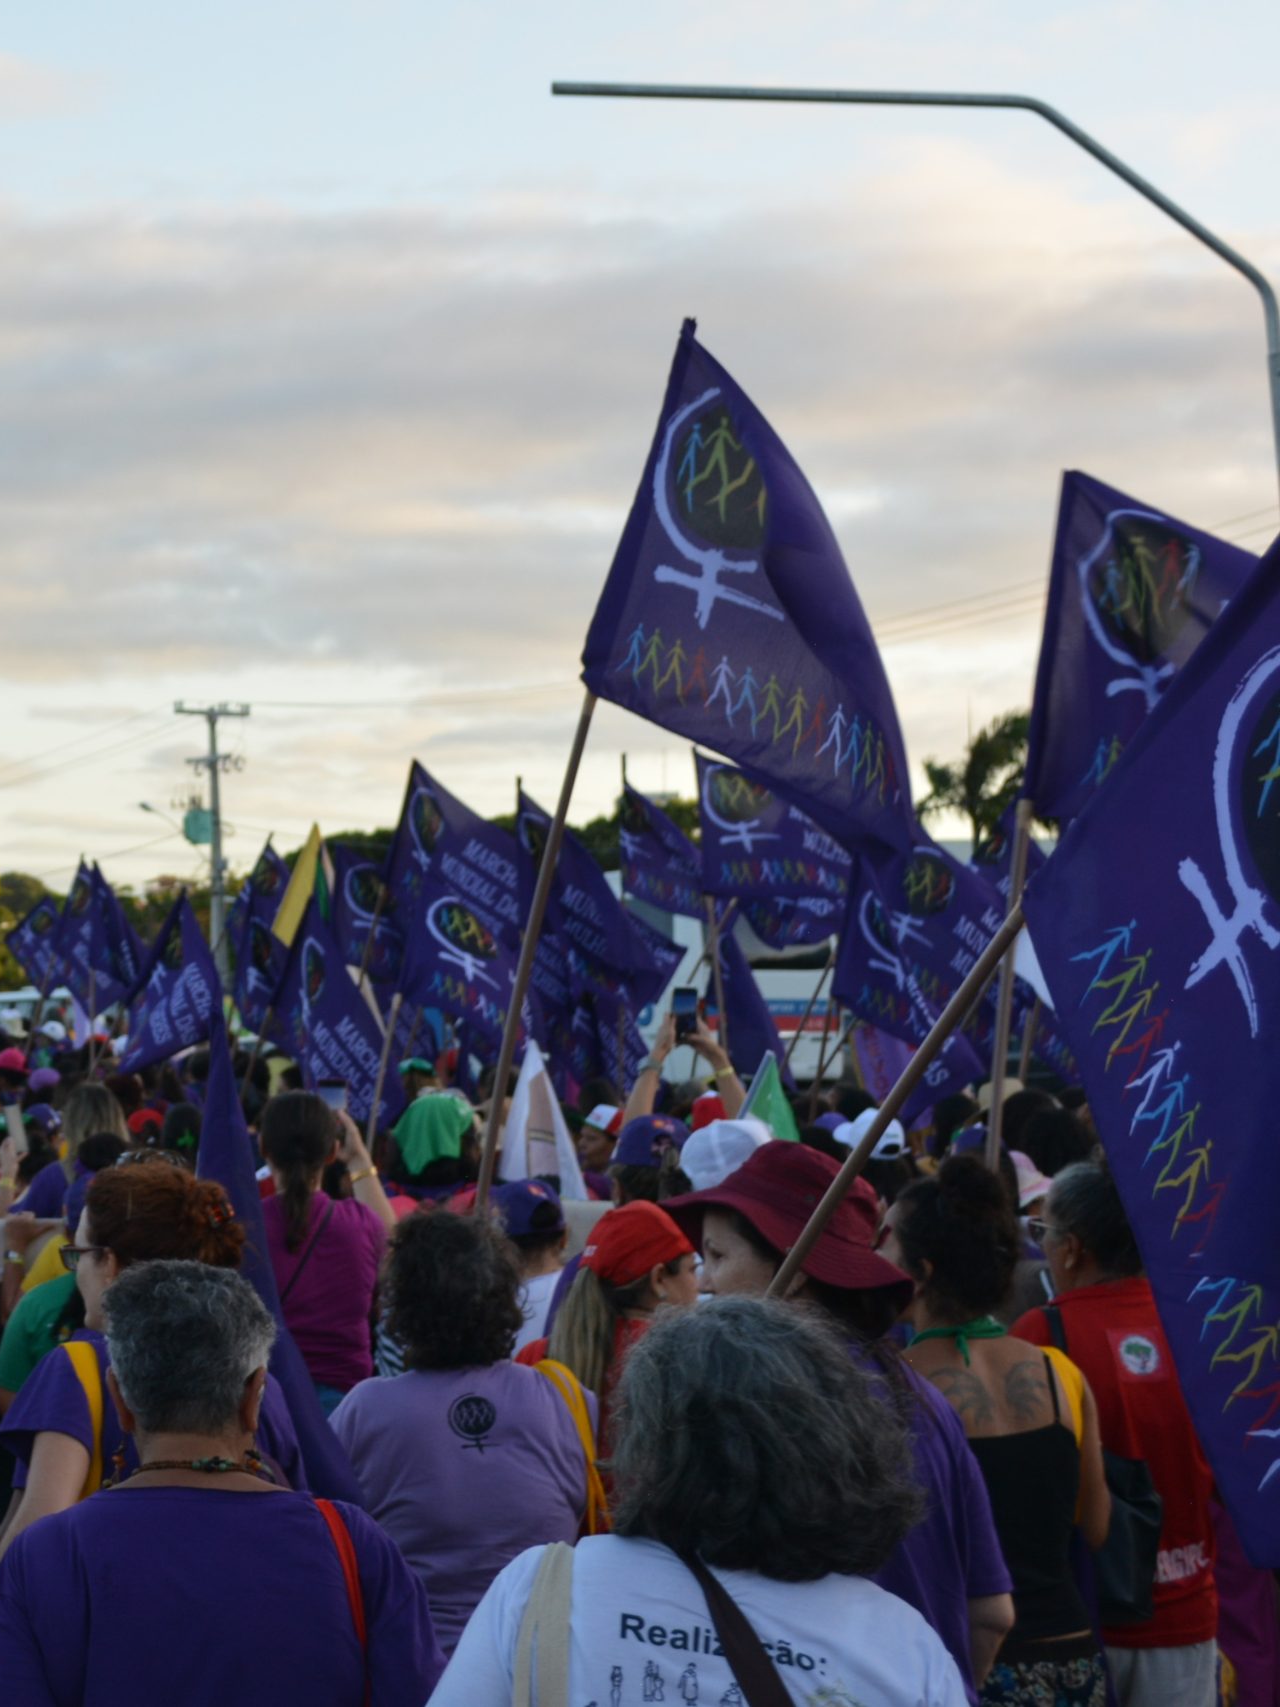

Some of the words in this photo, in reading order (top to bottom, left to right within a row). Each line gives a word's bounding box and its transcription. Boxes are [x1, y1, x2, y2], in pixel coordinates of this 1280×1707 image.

[441, 852, 498, 906] MUNDIAL
[494, 894, 520, 926] DA
[462, 838, 519, 889] MARCH
[312, 1020, 361, 1089] MUNDIAL
